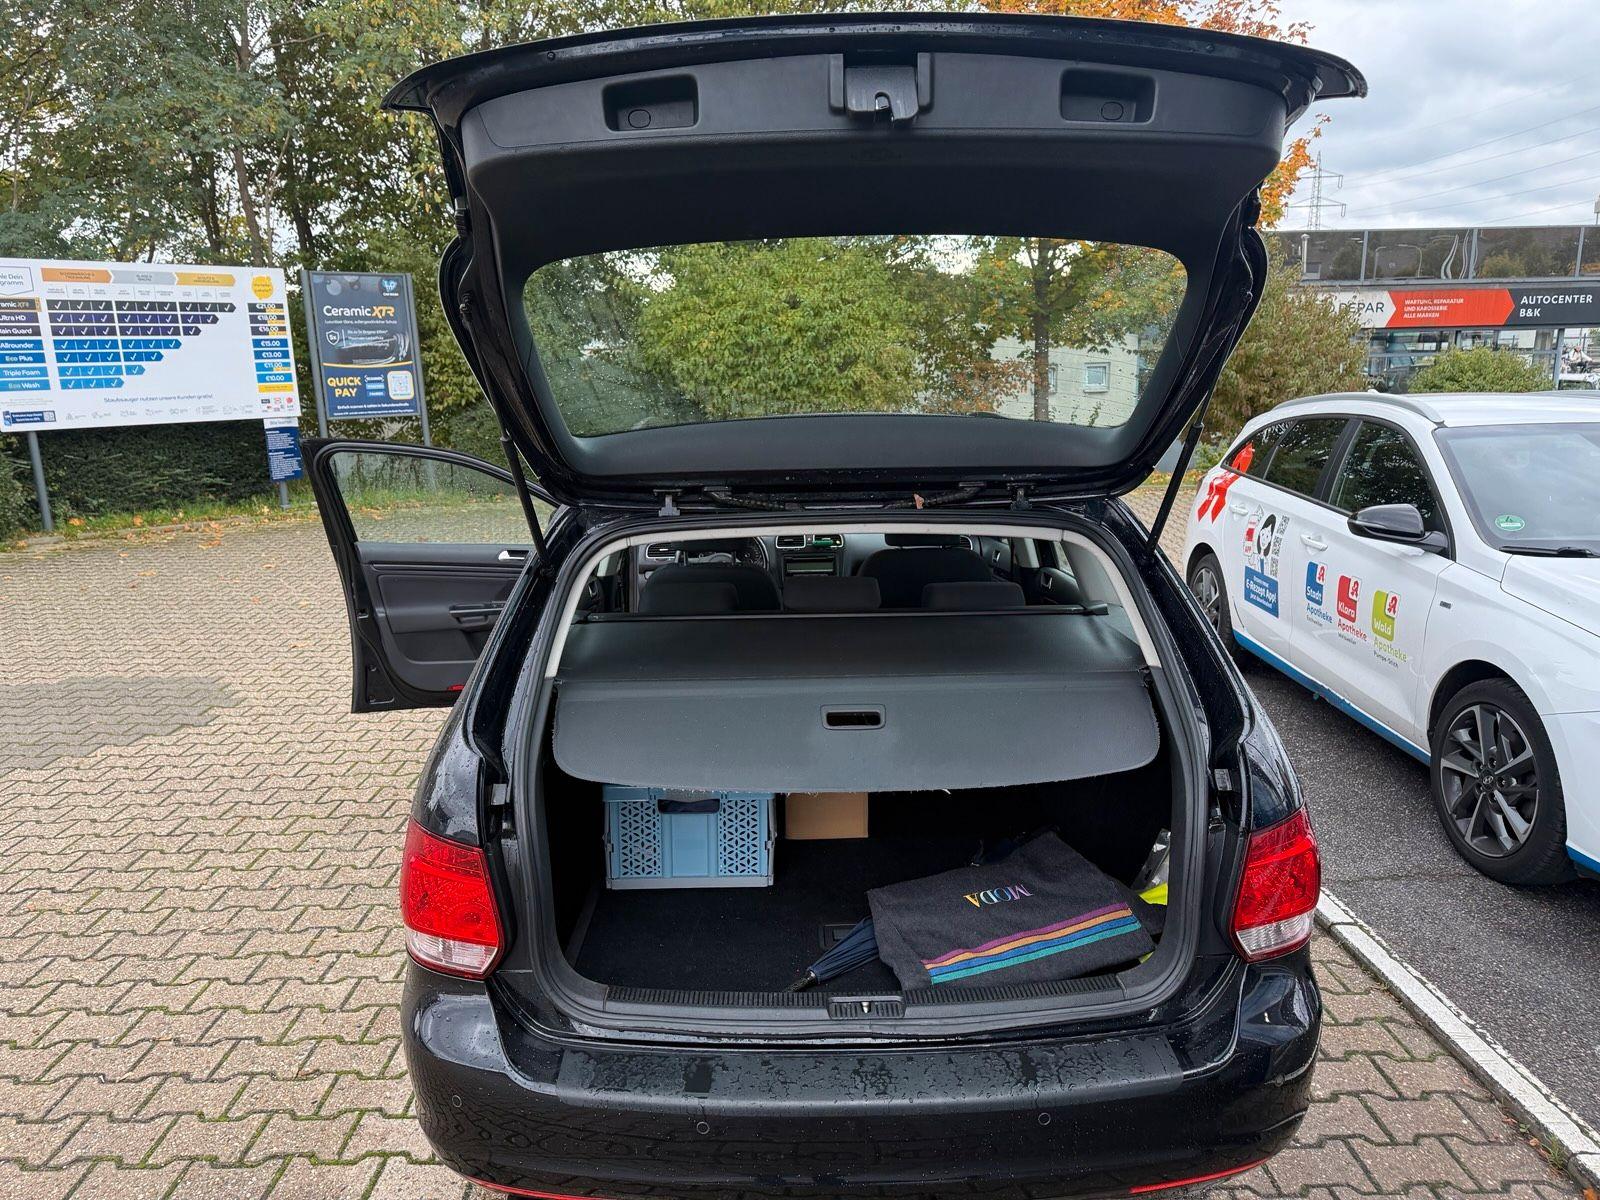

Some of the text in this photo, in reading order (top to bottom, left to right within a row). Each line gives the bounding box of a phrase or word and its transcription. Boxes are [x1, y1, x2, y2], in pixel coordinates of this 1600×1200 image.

[1520, 294, 1593, 305] AUTOCENTER
[1519, 308, 1541, 318] B&K
[327, 376, 362, 387] QUICK
[335, 388, 358, 397] PAY
[1306, 586, 1322, 602] Stadt
[1306, 603, 1333, 624] Apotheke
[1338, 602, 1355, 617] Klara
[1338, 619, 1367, 642] Apotheke
[1373, 618, 1391, 635] Wald
[1374, 637, 1407, 662] Apotheke
[963, 884, 1034, 908] MODA
